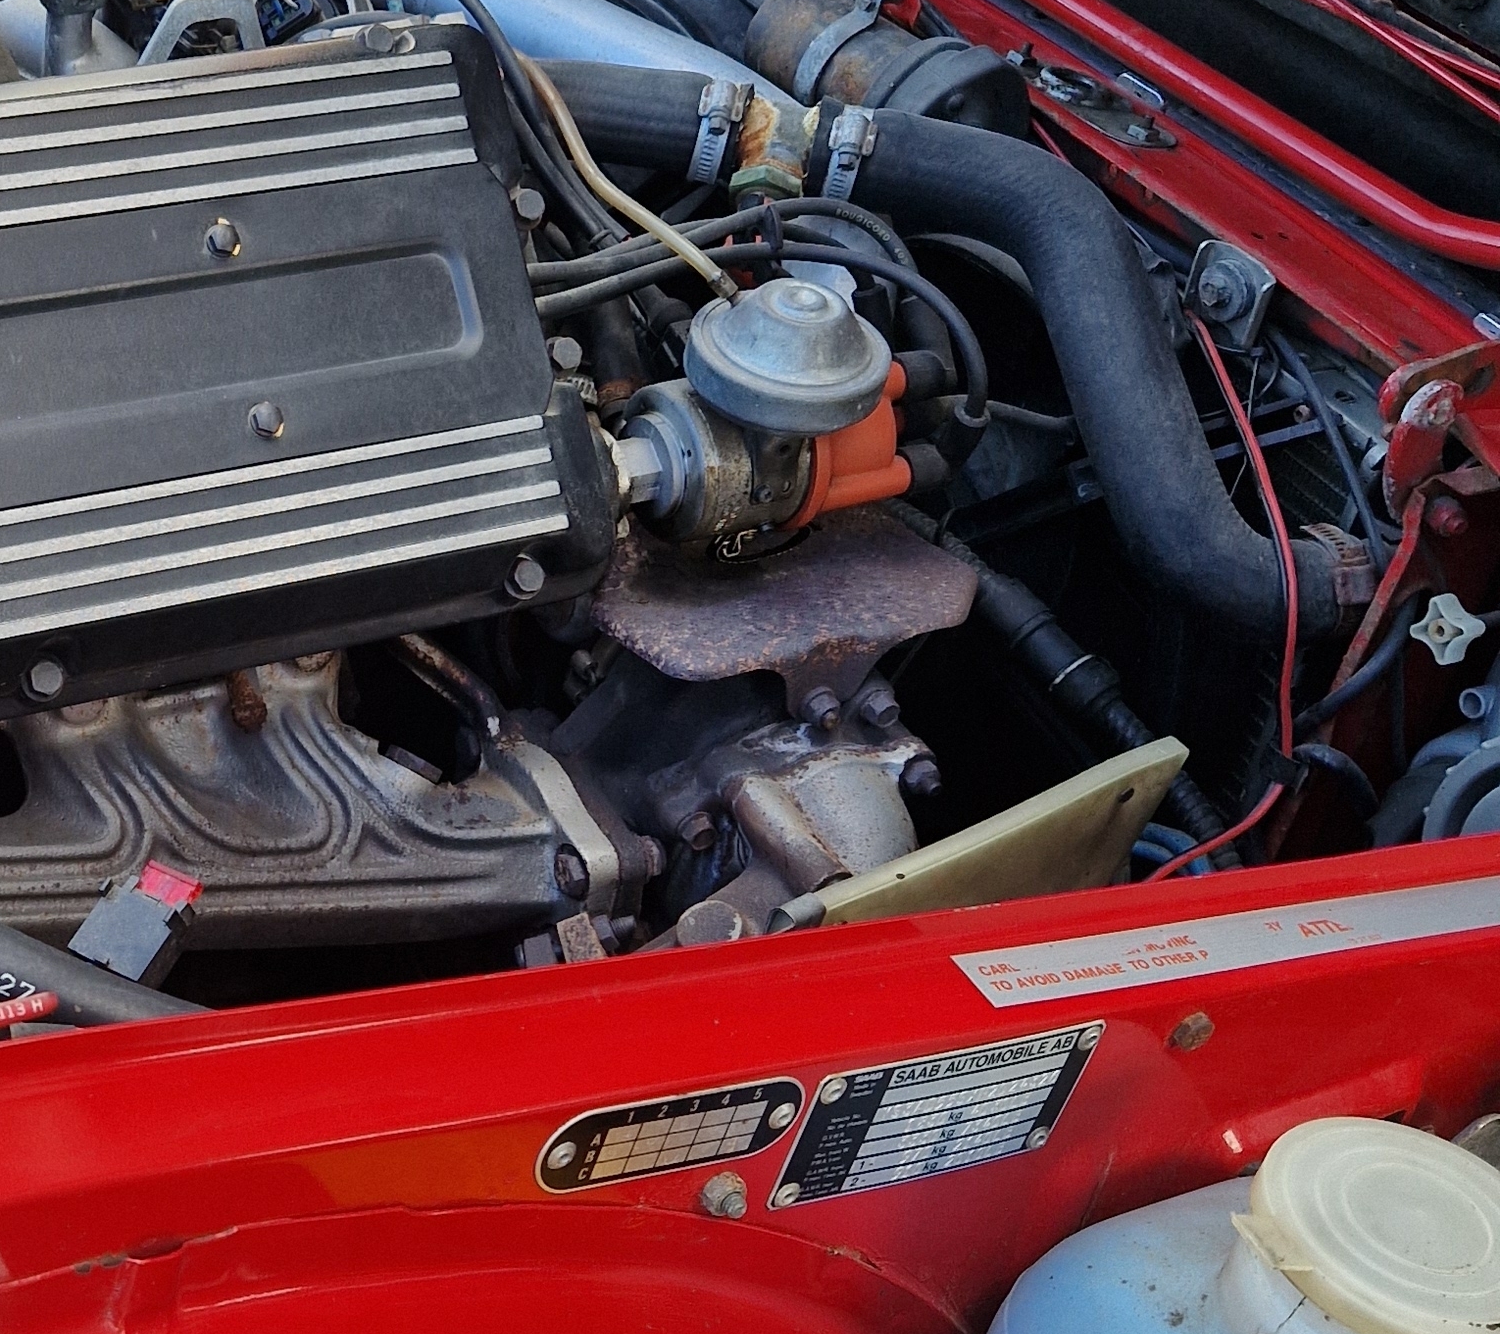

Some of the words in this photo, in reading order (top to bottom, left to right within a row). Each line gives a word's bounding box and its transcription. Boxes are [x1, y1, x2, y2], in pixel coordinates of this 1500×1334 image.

[989, 979, 1014, 992] TO
[1016, 973, 1062, 989] AVOID
[1064, 962, 1123, 982] DAMAGE
[1128, 957, 1150, 971] TO
[1151, 950, 1198, 968] OTHER
[30, 997, 45, 1013] H
[892, 1061, 942, 1085] SAAB
[942, 1039, 1049, 1074] AUTOMOBILE
[1049, 1034, 1075, 1052] AB
[627, 1111, 636, 1123] 1
[657, 1105, 669, 1118] 2
[689, 1099, 701, 1112] 3
[720, 1093, 731, 1106] 4
[753, 1087, 765, 1100] 5
[945, 1108, 965, 1123] kg
[589, 1133, 603, 1147] A
[937, 1126, 957, 1141] kg
[584, 1151, 596, 1164] B
[929, 1143, 948, 1157] kg
[577, 1167, 590, 1181] C
[920, 1159, 940, 1174] kg
